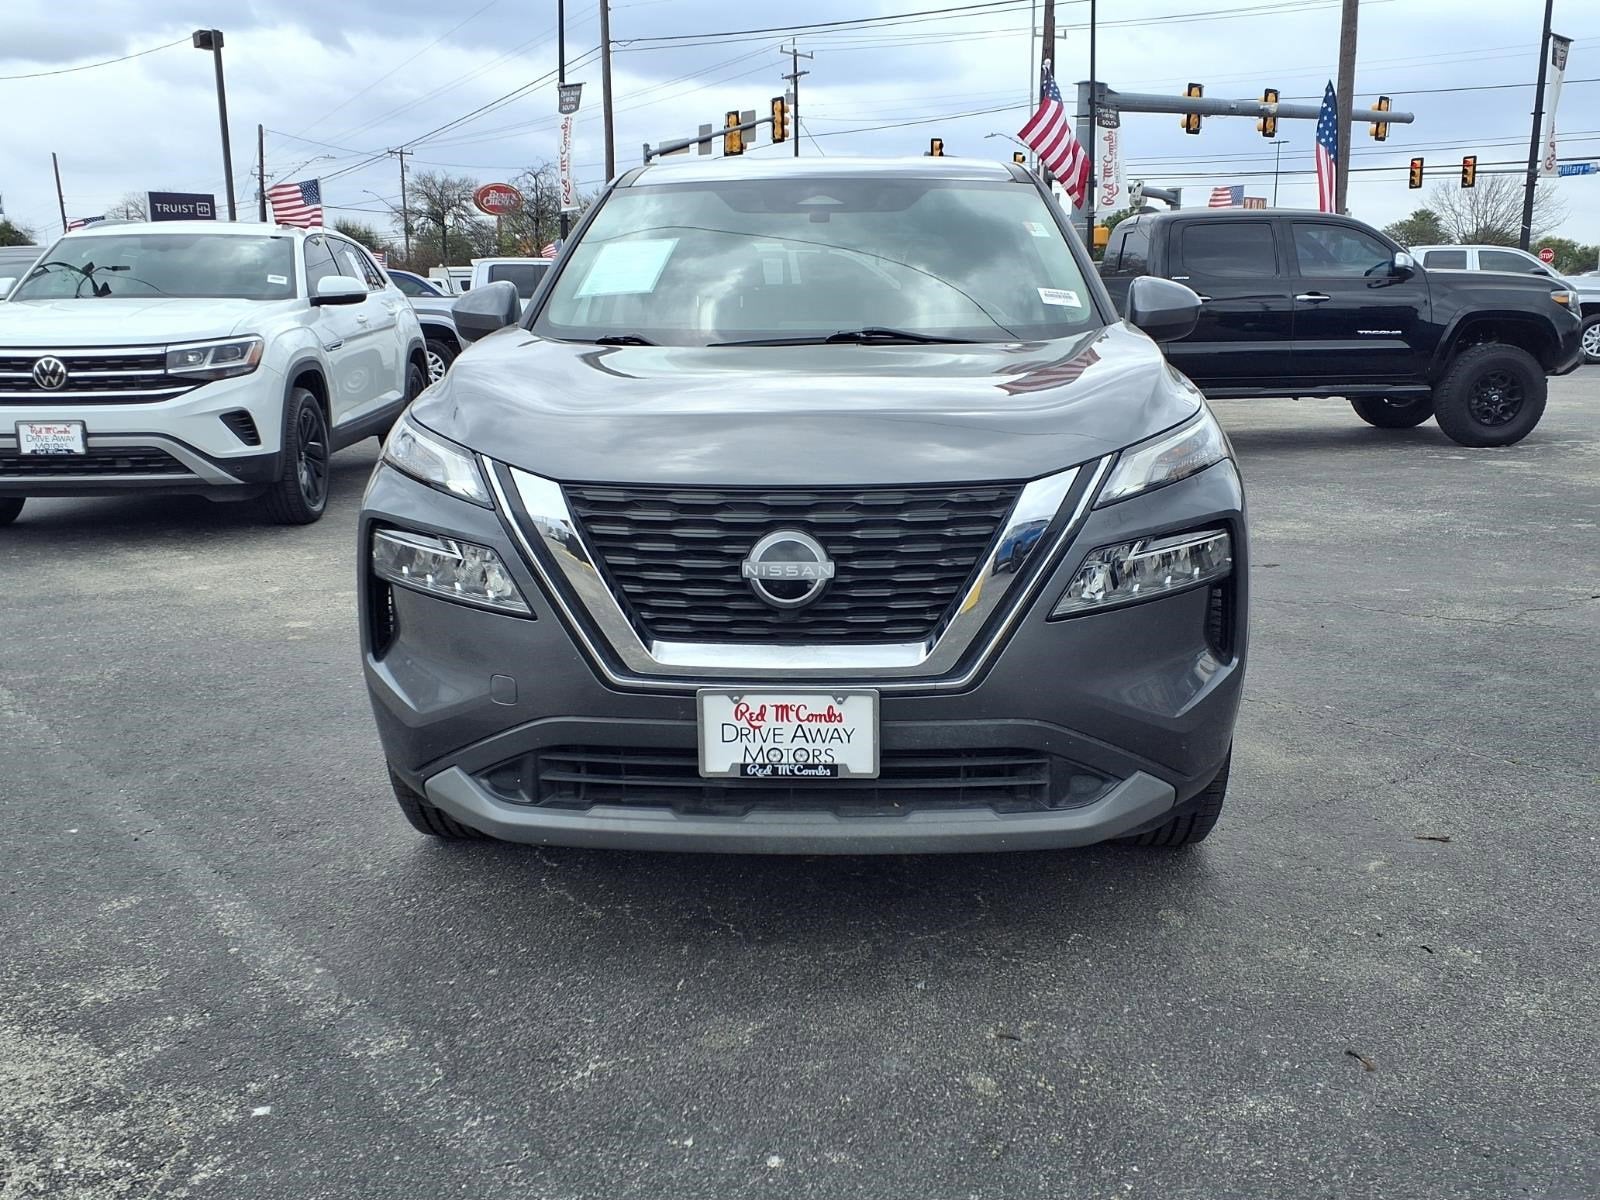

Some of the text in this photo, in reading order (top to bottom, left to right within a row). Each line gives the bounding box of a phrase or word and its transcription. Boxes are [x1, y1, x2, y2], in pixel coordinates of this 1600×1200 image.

[1103, 130, 1114, 181] McCombs
[1101, 183, 1120, 206] Red
[155, 203, 195, 213] TRUIST
[25, 434, 50, 443] DRIVE
[34, 442, 70, 450] MOTORS
[745, 564, 832, 577] NISSAN
[734, 702, 843, 729] Red McCombs
[721, 723, 855, 744] DRIVE AWAY
[743, 745, 835, 763] MOTORS
[746, 763, 831, 777] Red McCombs
